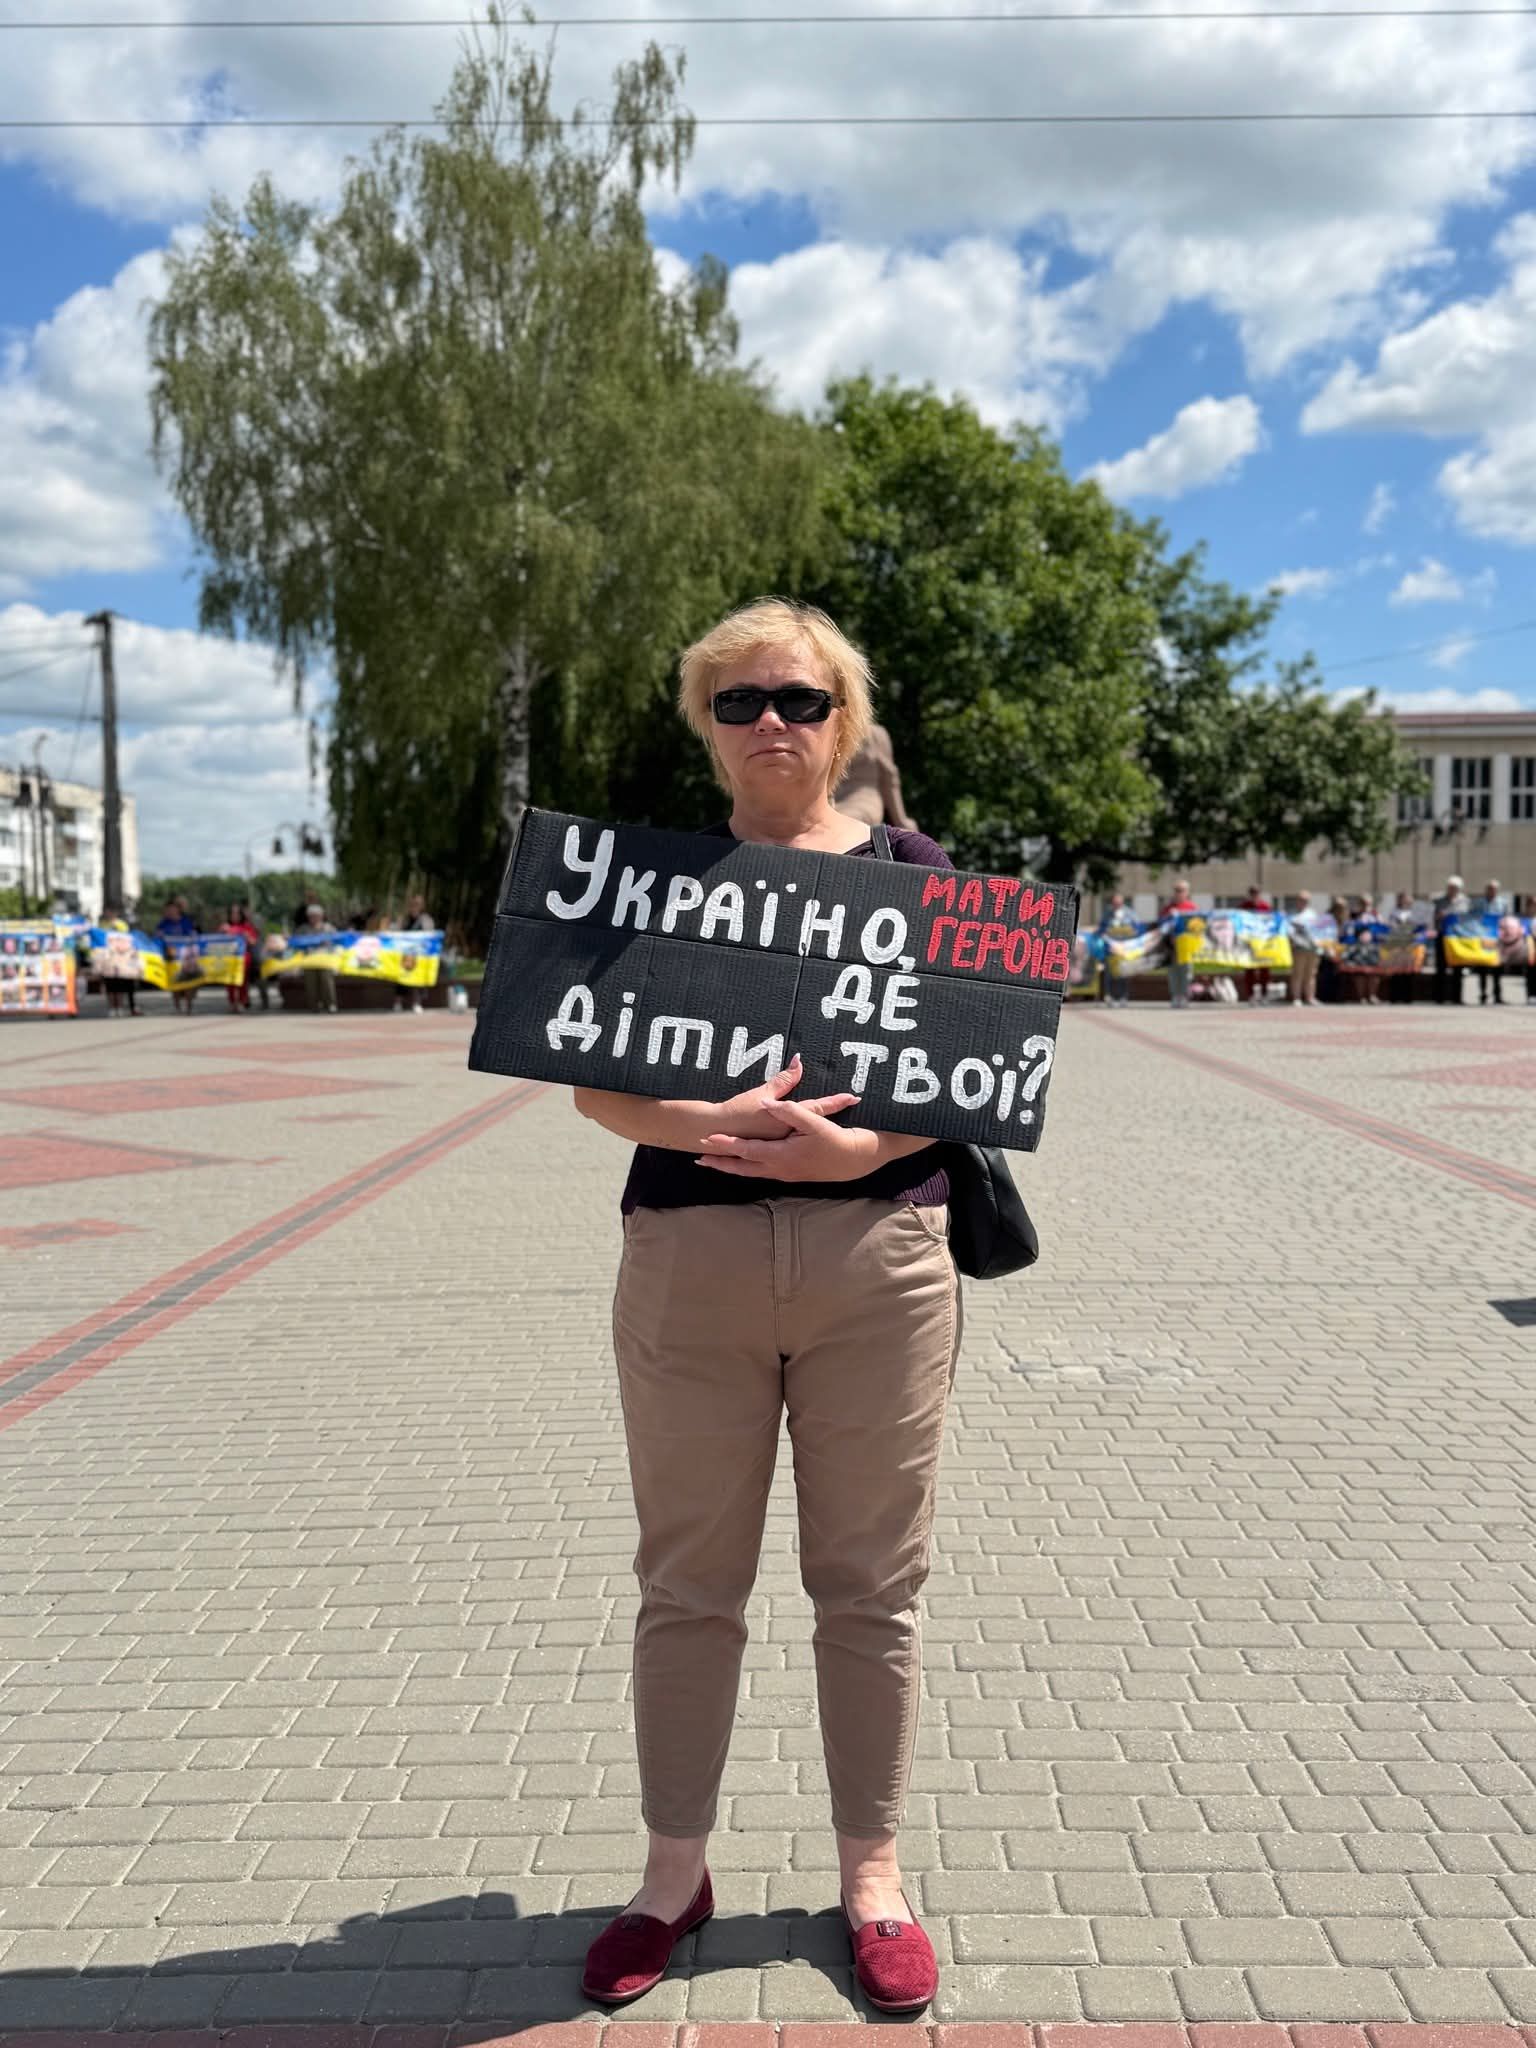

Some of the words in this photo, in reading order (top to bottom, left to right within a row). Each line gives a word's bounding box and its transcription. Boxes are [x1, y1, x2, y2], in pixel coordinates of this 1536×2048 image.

[922, 873, 1055, 927] МАТИ
[927, 916, 1070, 982] ГЕРОЇВ
[820, 964, 921, 1032] ДЕ
[840, 1034, 1055, 1126] ТВОЇ?
